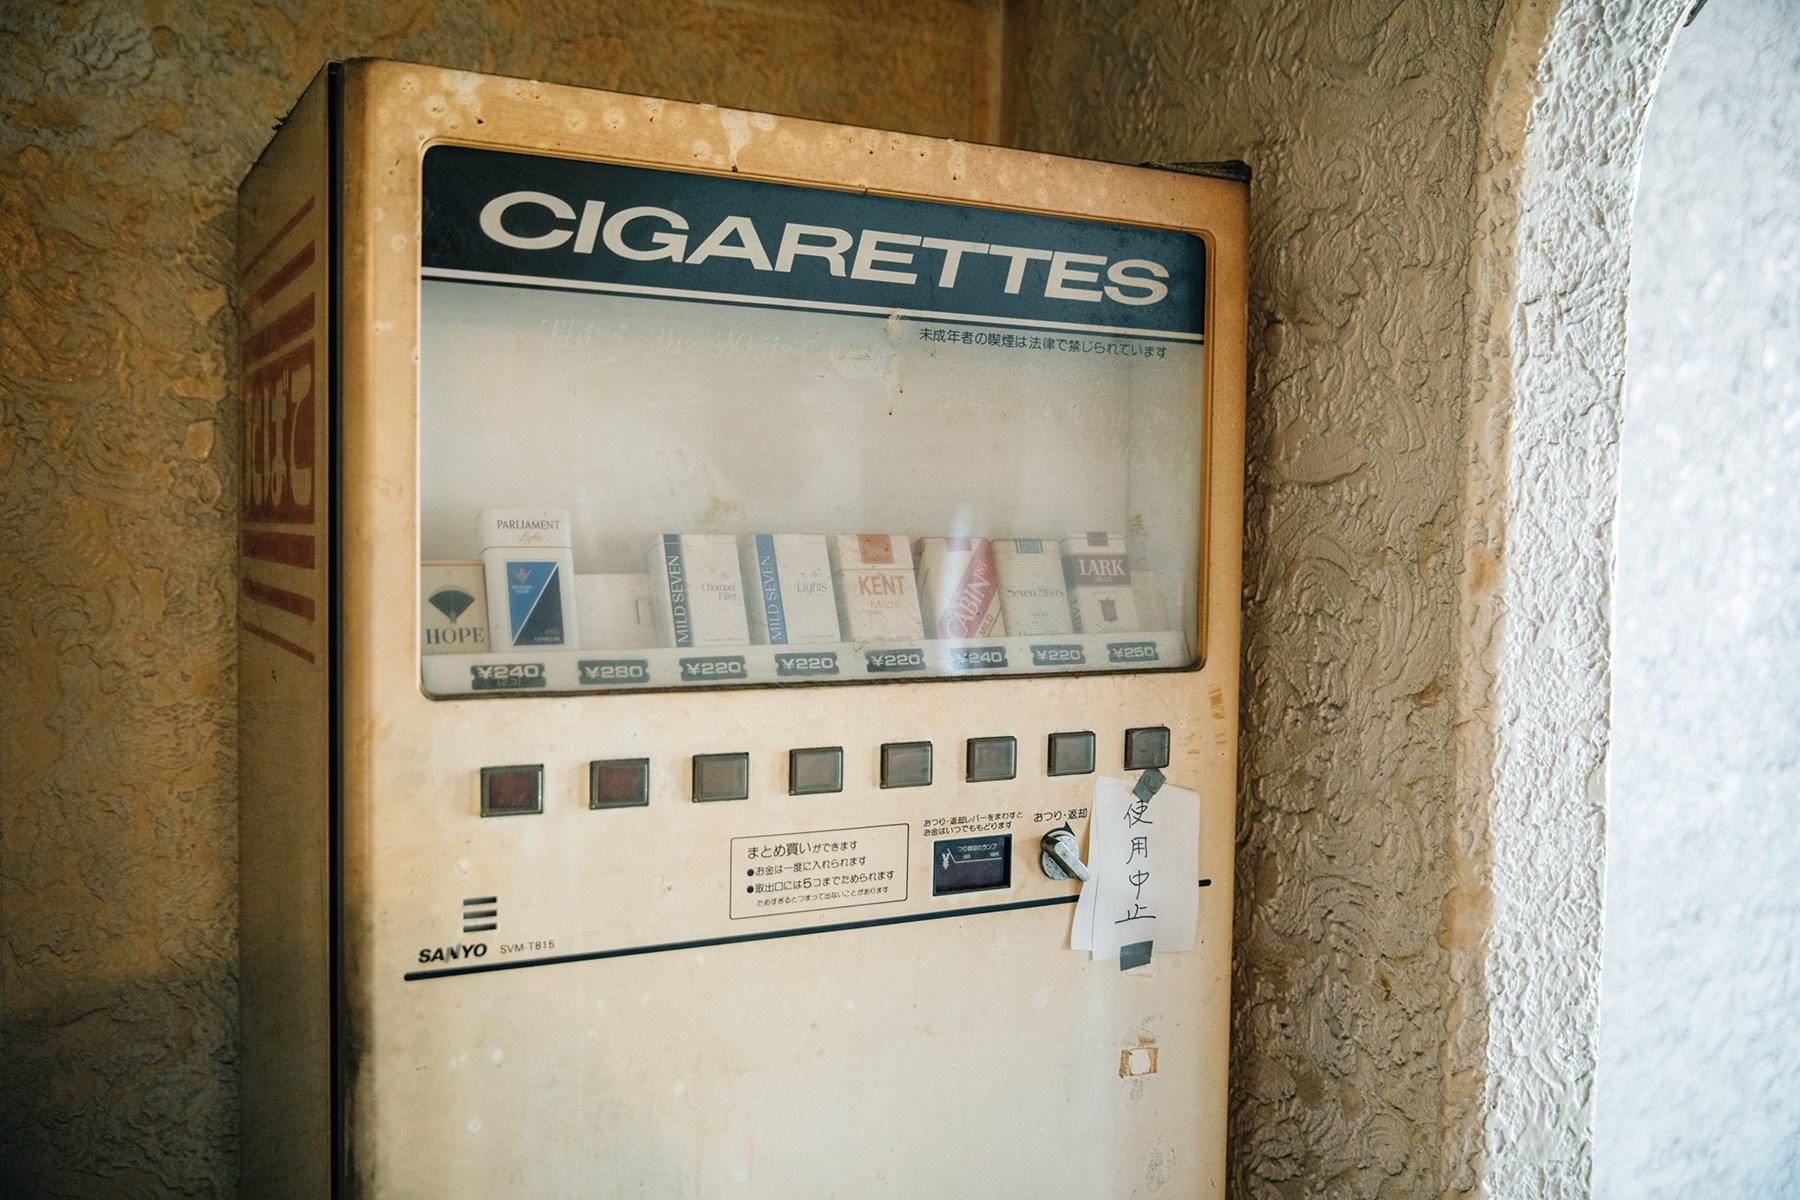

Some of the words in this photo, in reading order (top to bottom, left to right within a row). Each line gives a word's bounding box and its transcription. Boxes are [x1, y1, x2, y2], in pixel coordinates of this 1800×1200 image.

[479, 190, 1168, 306] CIGARETTES
[919, 328, 1167, 359] 未成年者の喫煙は法律で禁じられています
[496, 519, 560, 531] PARLIAMENT
[1079, 558, 1126, 576] LARK
[667, 555, 686, 602] SEVEN
[701, 582, 736, 593] Charcoal
[760, 554, 778, 602] SEVEN
[796, 580, 828, 595] Lights
[858, 575, 905, 596] KENT
[1007, 585, 1037, 598] Seven
[946, 571, 991, 639] CABIN
[674, 604, 689, 643] MILD
[767, 603, 783, 641] MILD
[979, 614, 994, 635] MILD
[425, 626, 486, 646] HOPE
[781, 657, 834, 671] ¥220
[871, 654, 921, 668] ¥220
[958, 651, 1003, 664] ¥240
[1036, 649, 1082, 661] ¥220
[477, 664, 540, 680] ¥240
[584, 665, 644, 679] ¥280
[686, 661, 742, 675] ¥220
[923, 811, 1024, 827] おつり・返却レバーをまわすと
[1033, 807, 1088, 823] おつり・返却
[923, 821, 1013, 837] お金はいつでももどります
[747, 840, 858, 860] まとめ買いができます
[755, 856, 867, 876] お金は一度に入れられます
[1115, 799, 1156, 924] 使用中止
[755, 870, 895, 894] 取出口には5コまでためられます
[756, 886, 889, 907] ためすぎるとつまって出ないことがあります
[418, 943, 488, 963] SANYO
